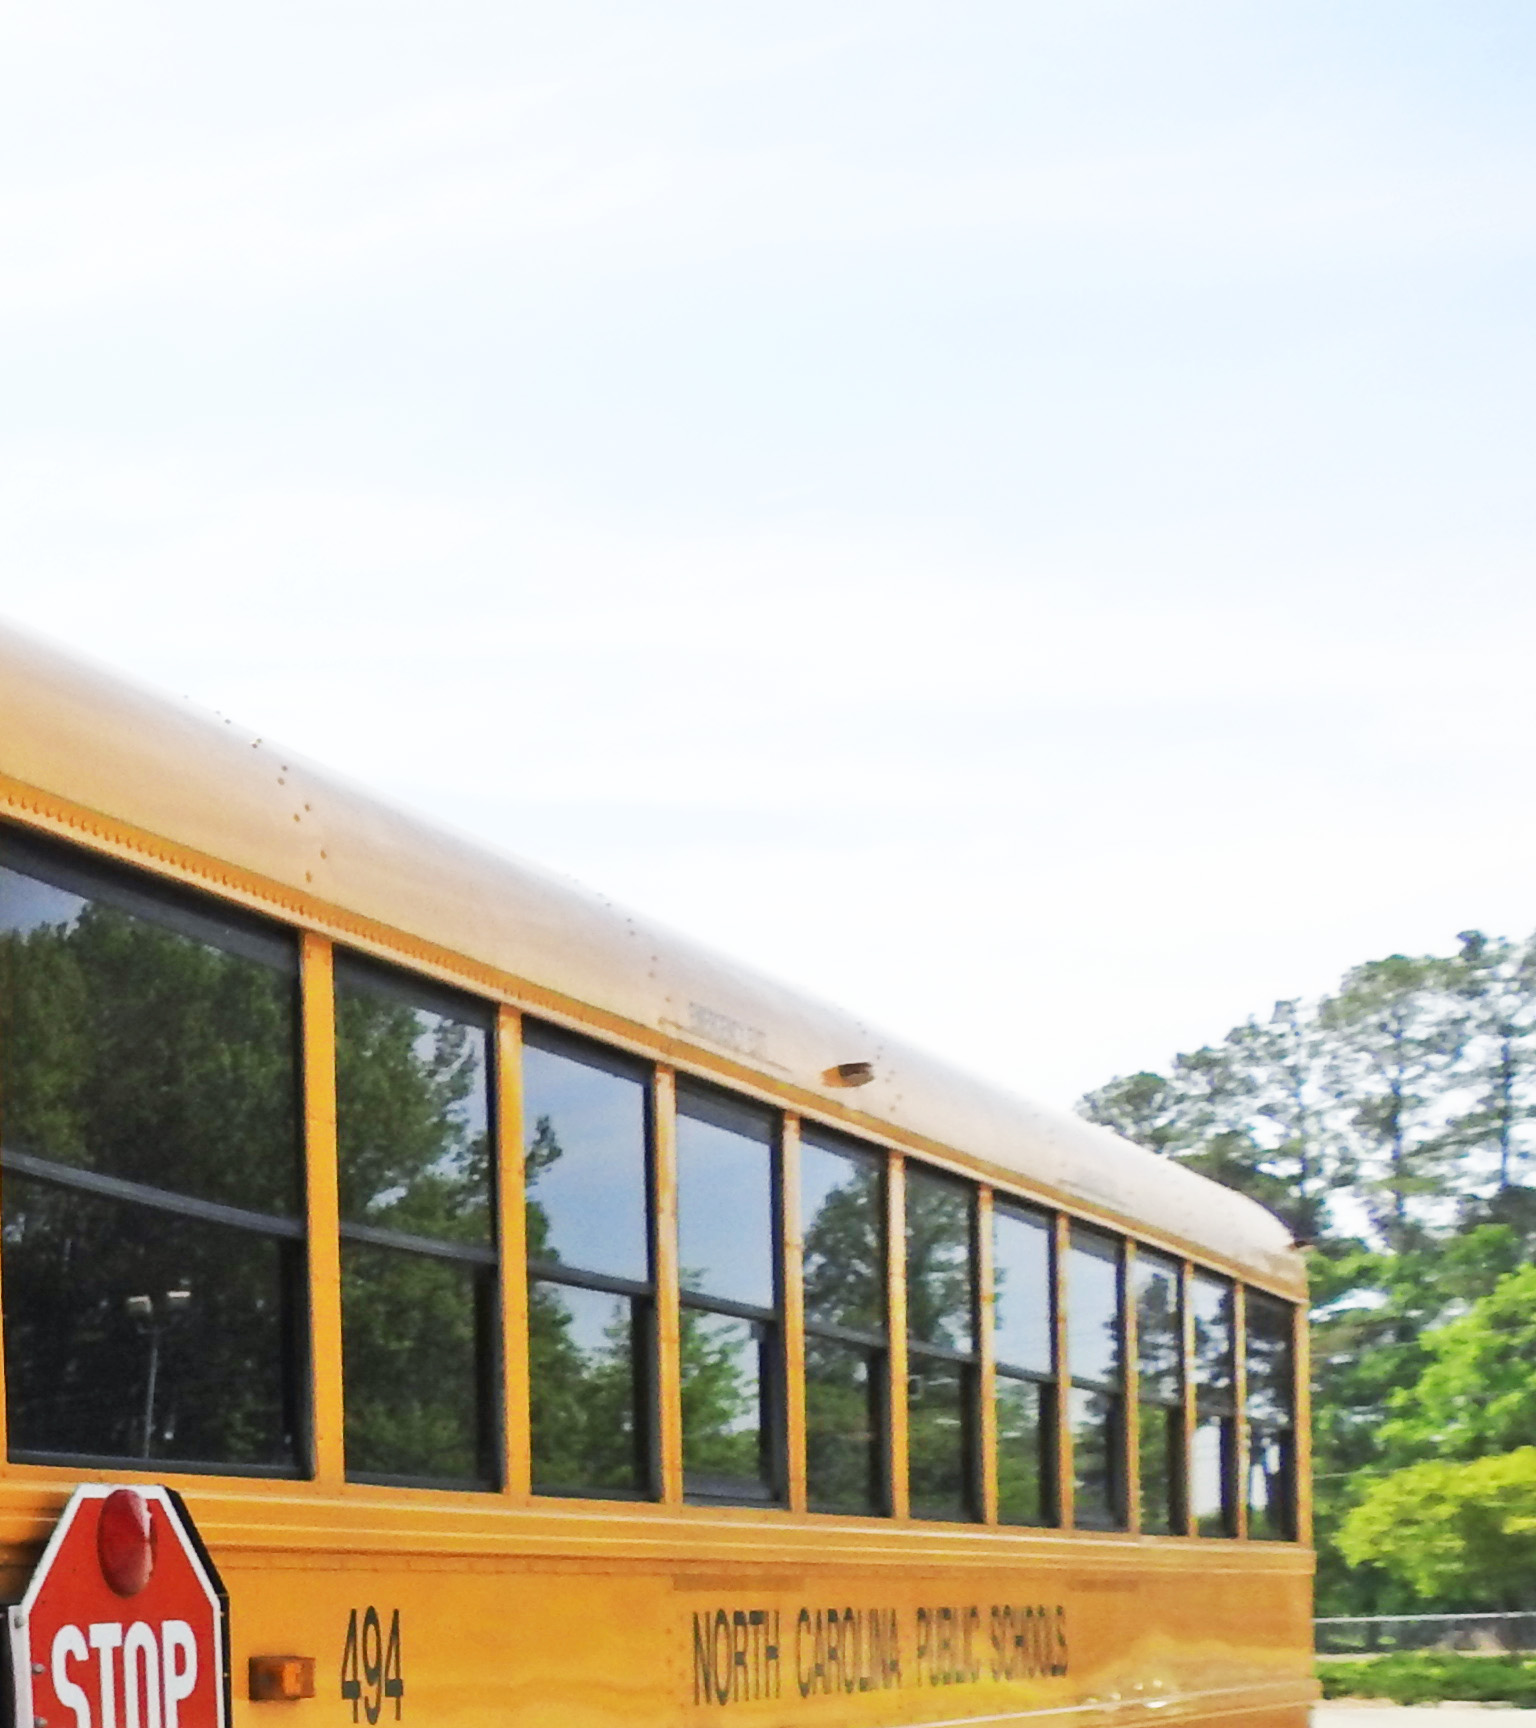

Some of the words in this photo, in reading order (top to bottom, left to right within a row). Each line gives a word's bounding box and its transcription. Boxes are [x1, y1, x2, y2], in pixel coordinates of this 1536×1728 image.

[341, 1605, 404, 1725] 494
[692, 1608, 780, 1706] NORTH
[796, 1606, 902, 1699] CAROLINA
